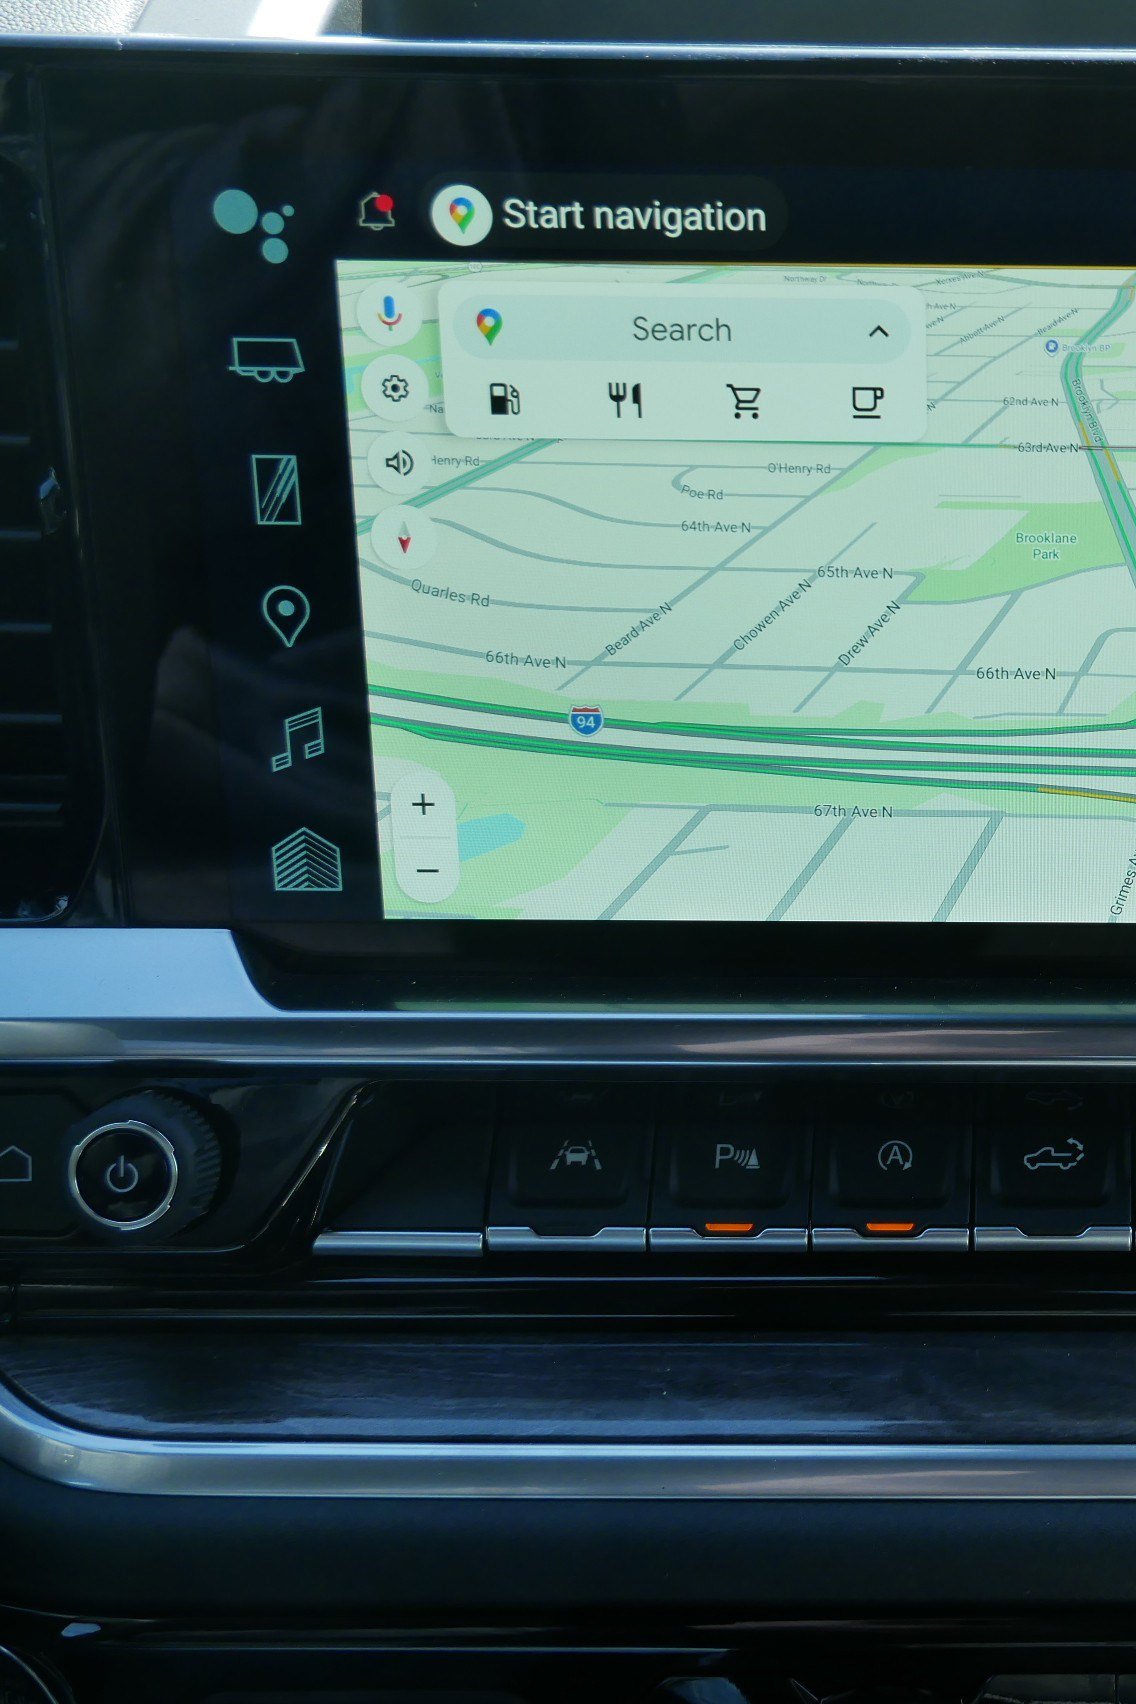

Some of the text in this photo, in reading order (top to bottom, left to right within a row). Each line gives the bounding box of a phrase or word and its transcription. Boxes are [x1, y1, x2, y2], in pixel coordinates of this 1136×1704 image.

[503, 198, 767, 237] Start navigation
[632, 315, 733, 344] Search
[1003, 397, 1060, 407] 62nd Ave N
[1072, 378, 1102, 443] Brooklyn Blvd
[1018, 442, 1079, 453] 63rd Ave N
[767, 462, 831, 476] O'Henry Rd
[680, 484, 724, 500] Poe Rd
[681, 520, 752, 533] 64th Ave N
[1016, 532, 1077, 544] Brooklane
[1032, 549, 1060, 560] Park
[817, 566, 893, 578] 65th Ave N
[411, 578, 490, 608] Quarles Rd
[732, 578, 812, 651] Chowen Ave N
[604, 602, 672, 656] Beard Ave N
[838, 600, 901, 666] Drew Ave N
[486, 651, 567, 669] 66th Ave N
[976, 668, 1056, 680] 66th Ave N
[577, 716, 595, 728] 94
[814, 804, 894, 818] 67th Ave N
[1110, 870, 1136, 916] Grimes
